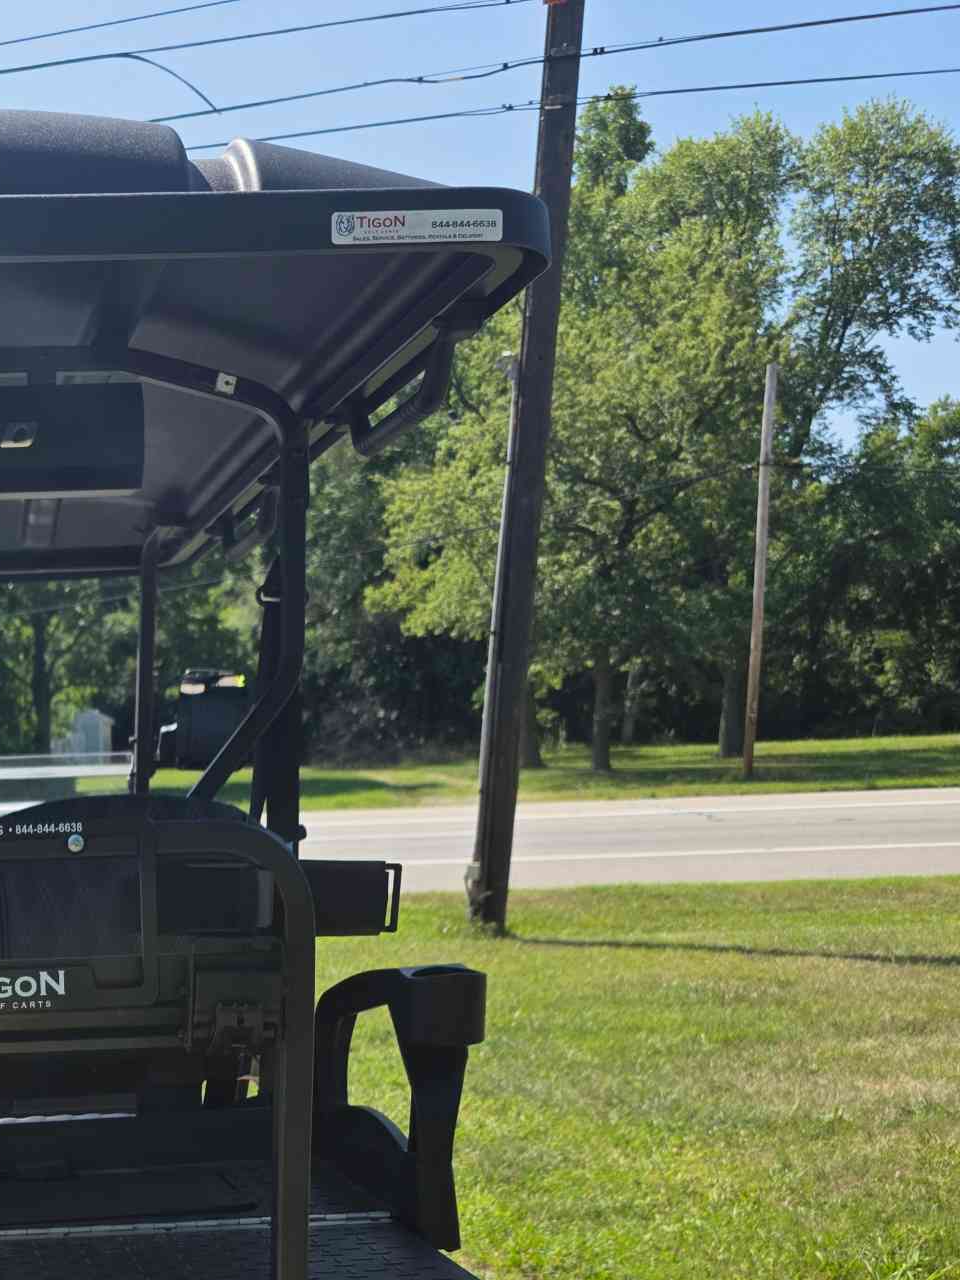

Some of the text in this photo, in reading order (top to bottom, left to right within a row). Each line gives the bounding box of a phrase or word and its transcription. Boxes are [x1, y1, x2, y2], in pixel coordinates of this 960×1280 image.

[356, 214, 406, 229] TIGON
[15, 822, 83, 835] 844-844-6638
[12, 1001, 52, 1010] CARTS
